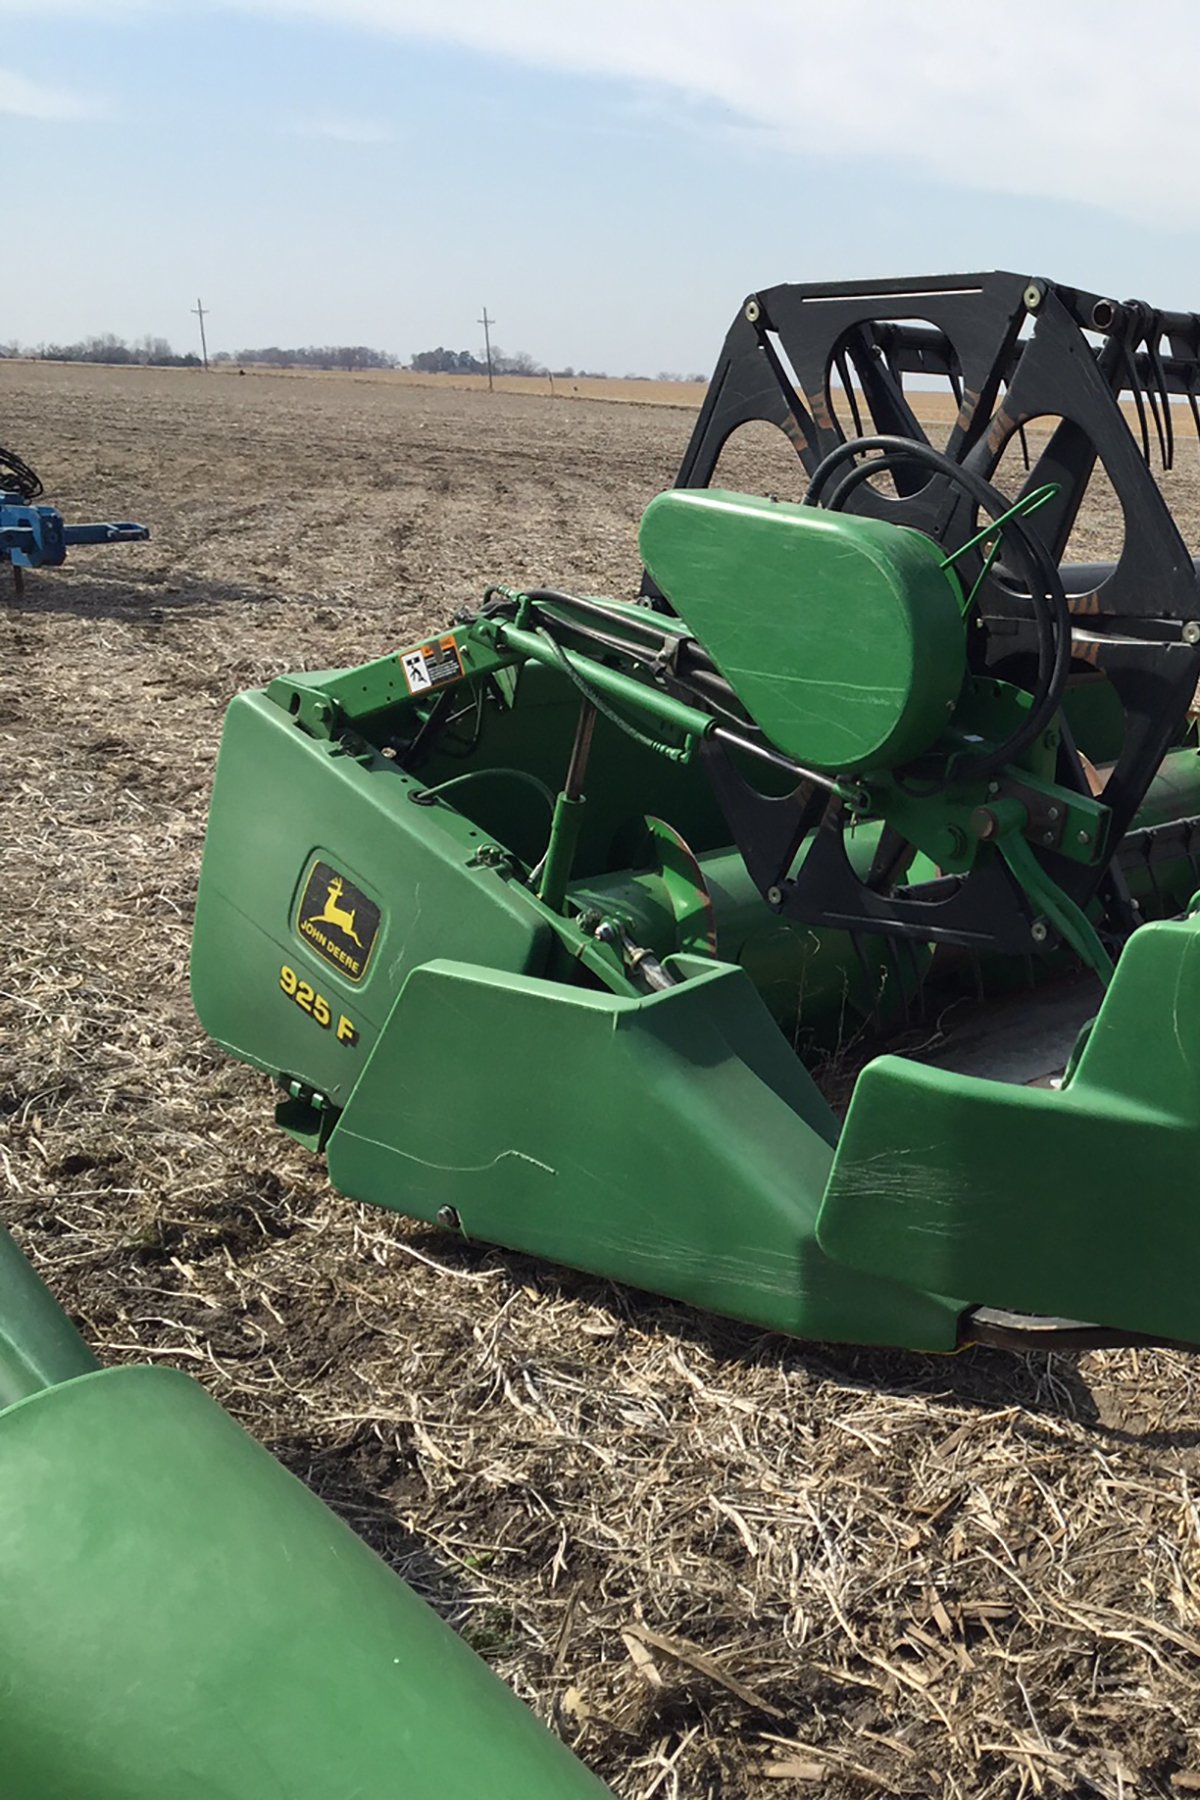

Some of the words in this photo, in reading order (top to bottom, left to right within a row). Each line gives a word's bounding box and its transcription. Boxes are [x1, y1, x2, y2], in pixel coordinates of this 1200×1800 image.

[300, 920, 326, 947] JOHN
[327, 940, 360, 974] DEERE
[280, 965, 331, 1028] 925
[336, 1014, 357, 1043] F
